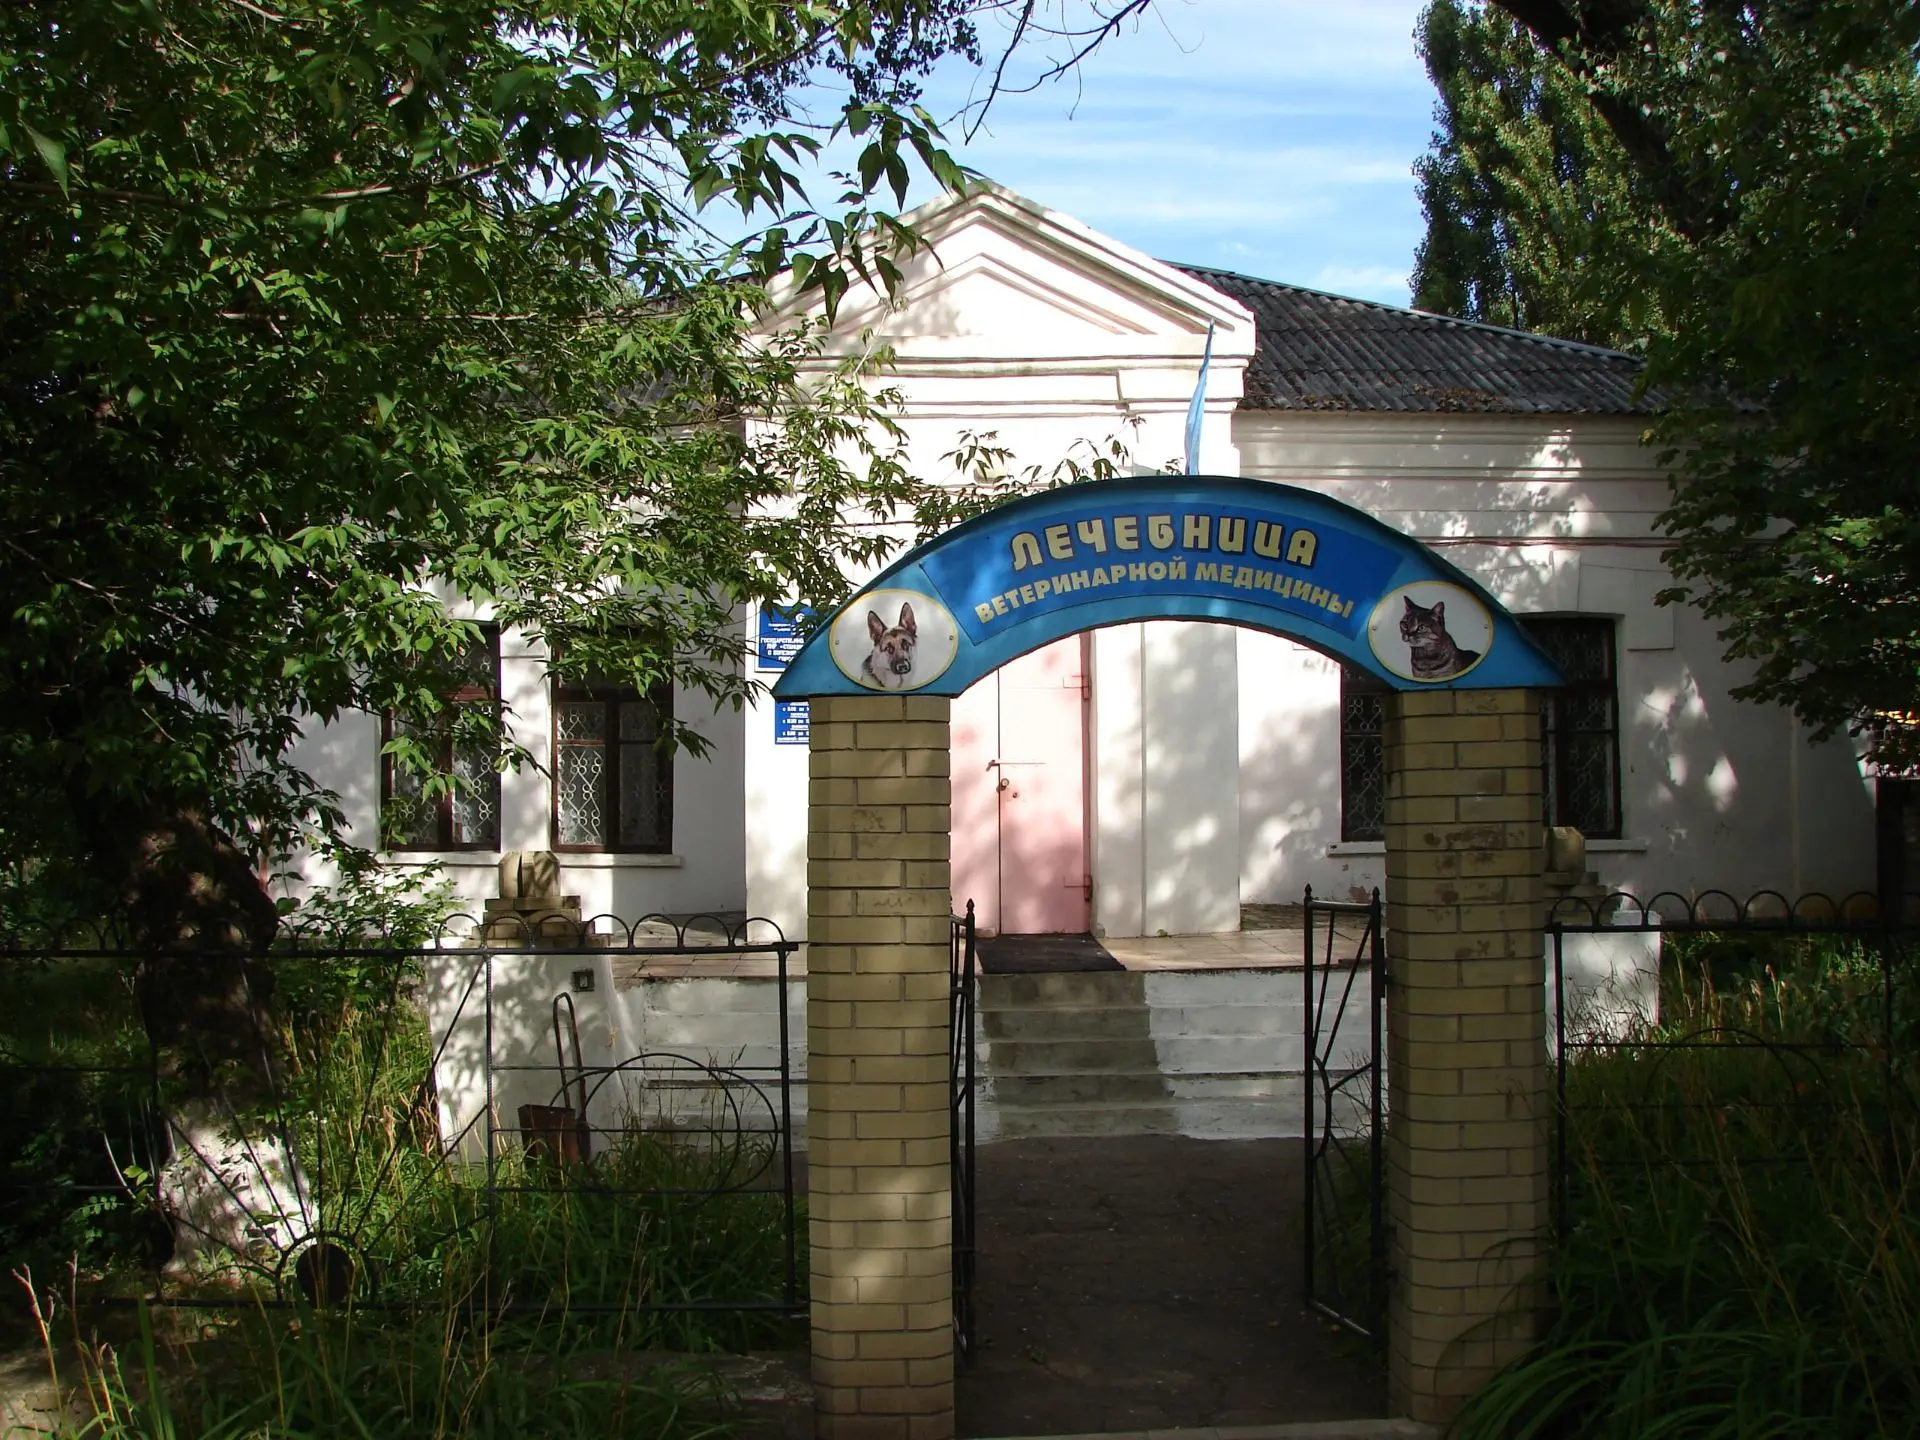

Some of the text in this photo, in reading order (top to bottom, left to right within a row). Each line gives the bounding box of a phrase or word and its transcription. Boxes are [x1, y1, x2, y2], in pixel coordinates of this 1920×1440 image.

[1011, 515, 1317, 571] ЛЕЧЕБНИЦА
[974, 556, 1354, 623] ВЕТЕРИНАРНОЙ МЕДИЦИНЫ
